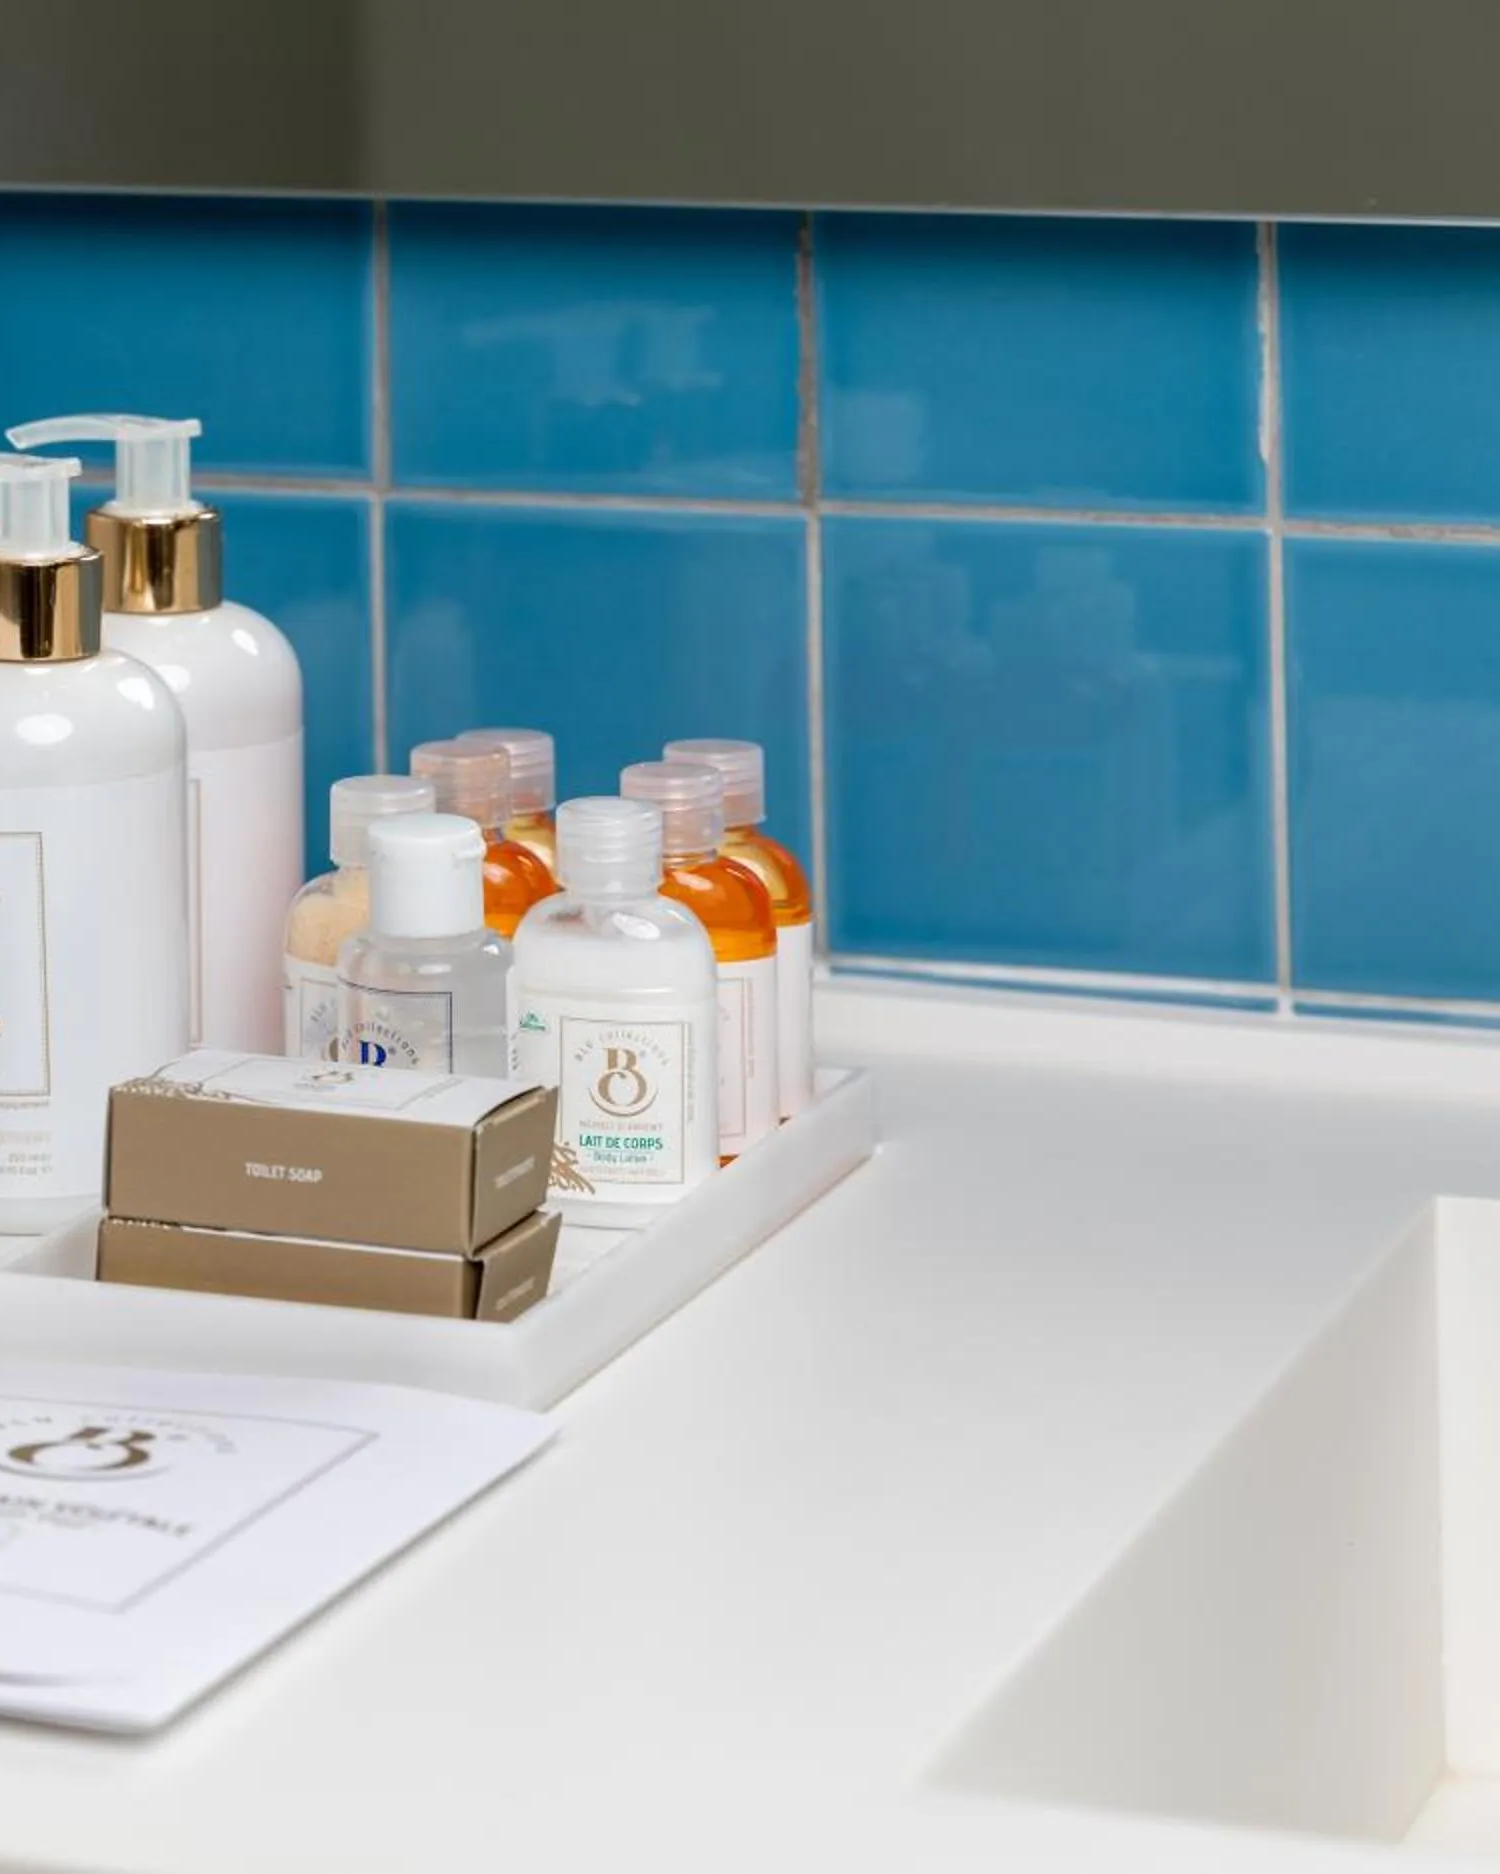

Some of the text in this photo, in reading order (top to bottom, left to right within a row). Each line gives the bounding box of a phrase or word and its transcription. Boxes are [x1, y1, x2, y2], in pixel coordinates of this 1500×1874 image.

[579, 1134, 664, 1151] LAIT DE CORPS
[243, 1161, 323, 1183] TOILET SOAP
